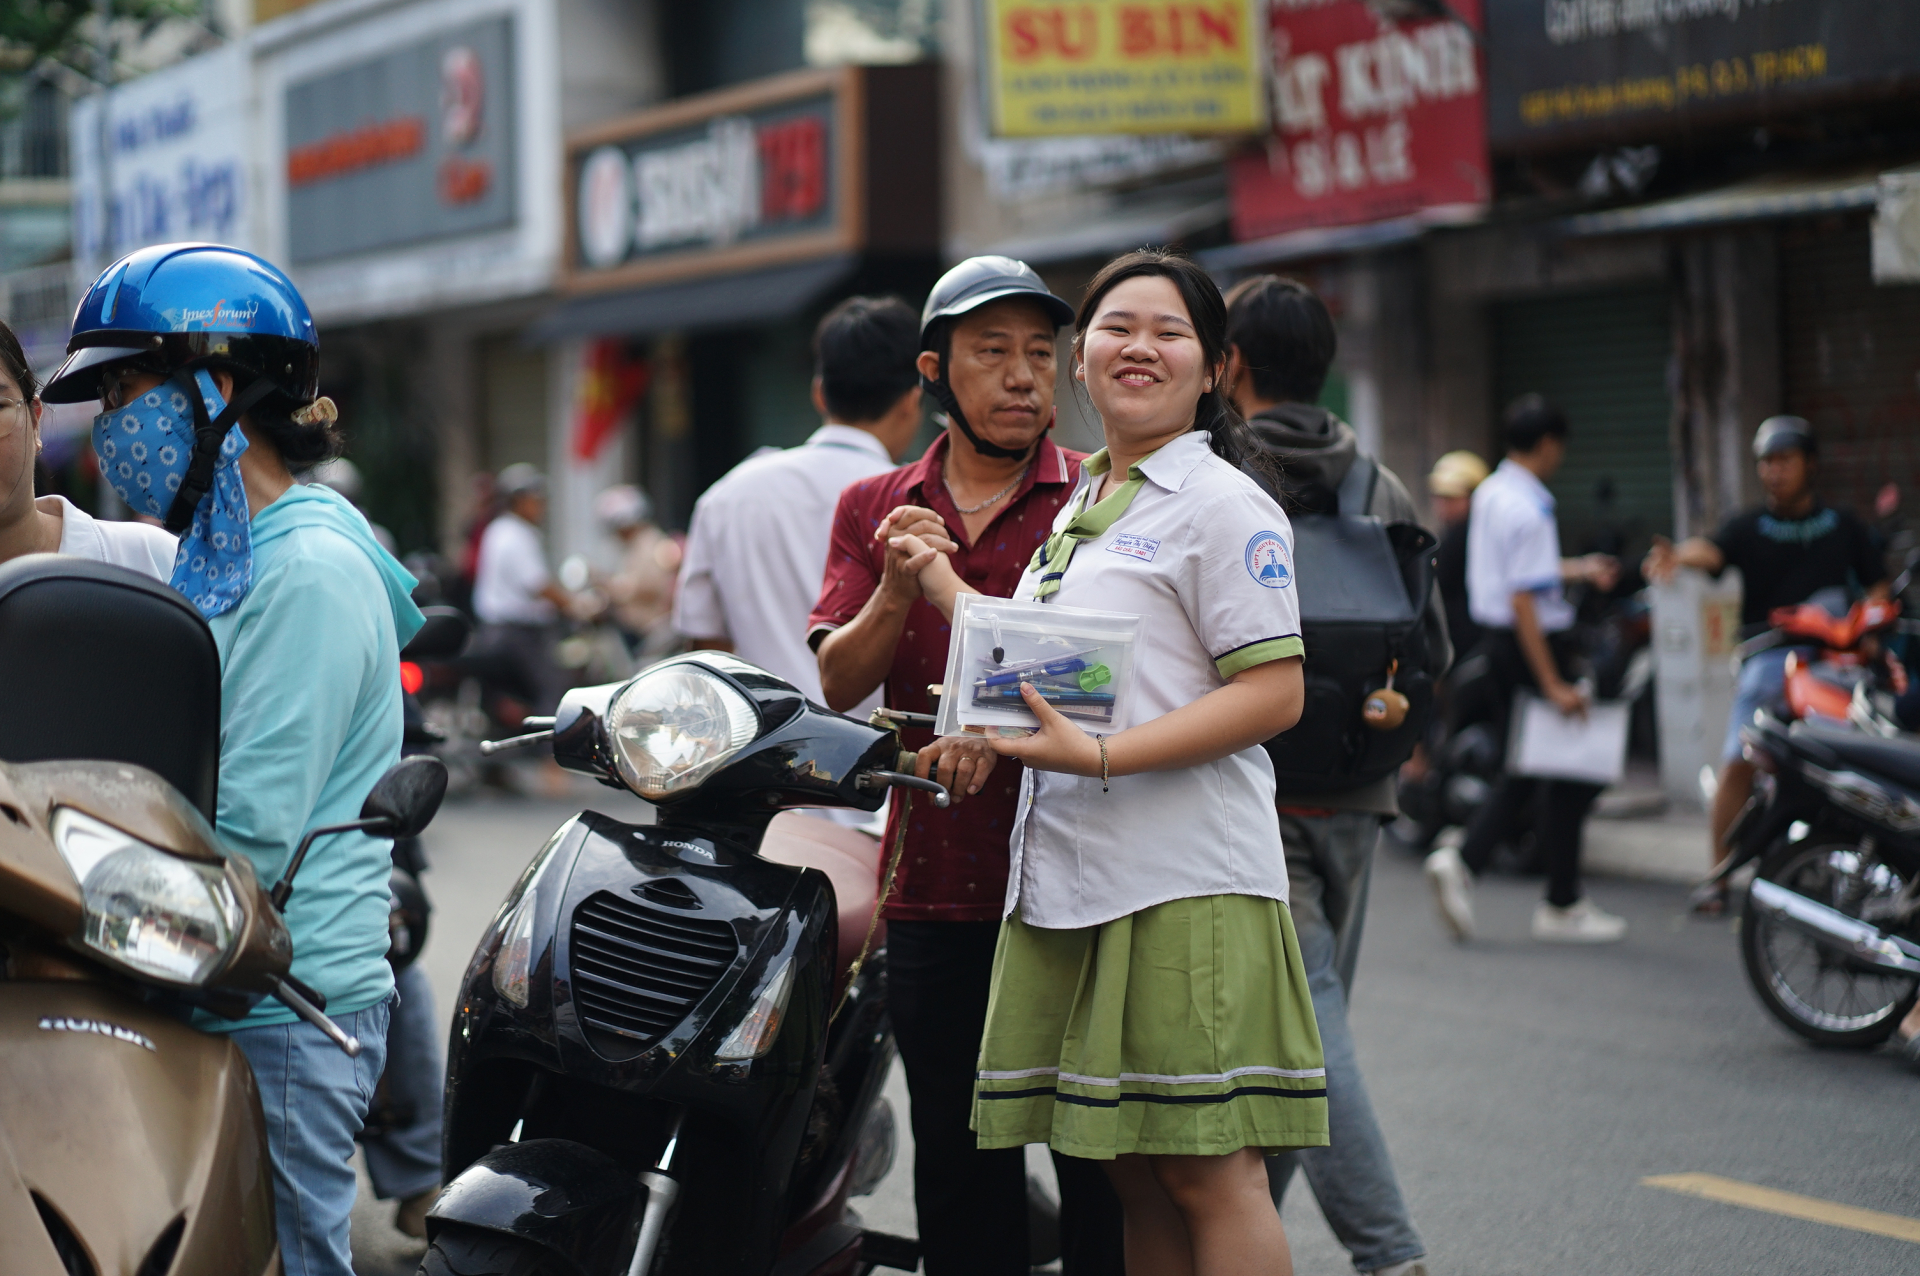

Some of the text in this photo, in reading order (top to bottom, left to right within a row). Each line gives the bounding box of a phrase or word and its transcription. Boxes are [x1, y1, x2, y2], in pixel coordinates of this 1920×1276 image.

[1005, 1, 1239, 62] SU BIN
[661, 840, 716, 860] HONDA
[38, 1017, 157, 1052] HONDA
